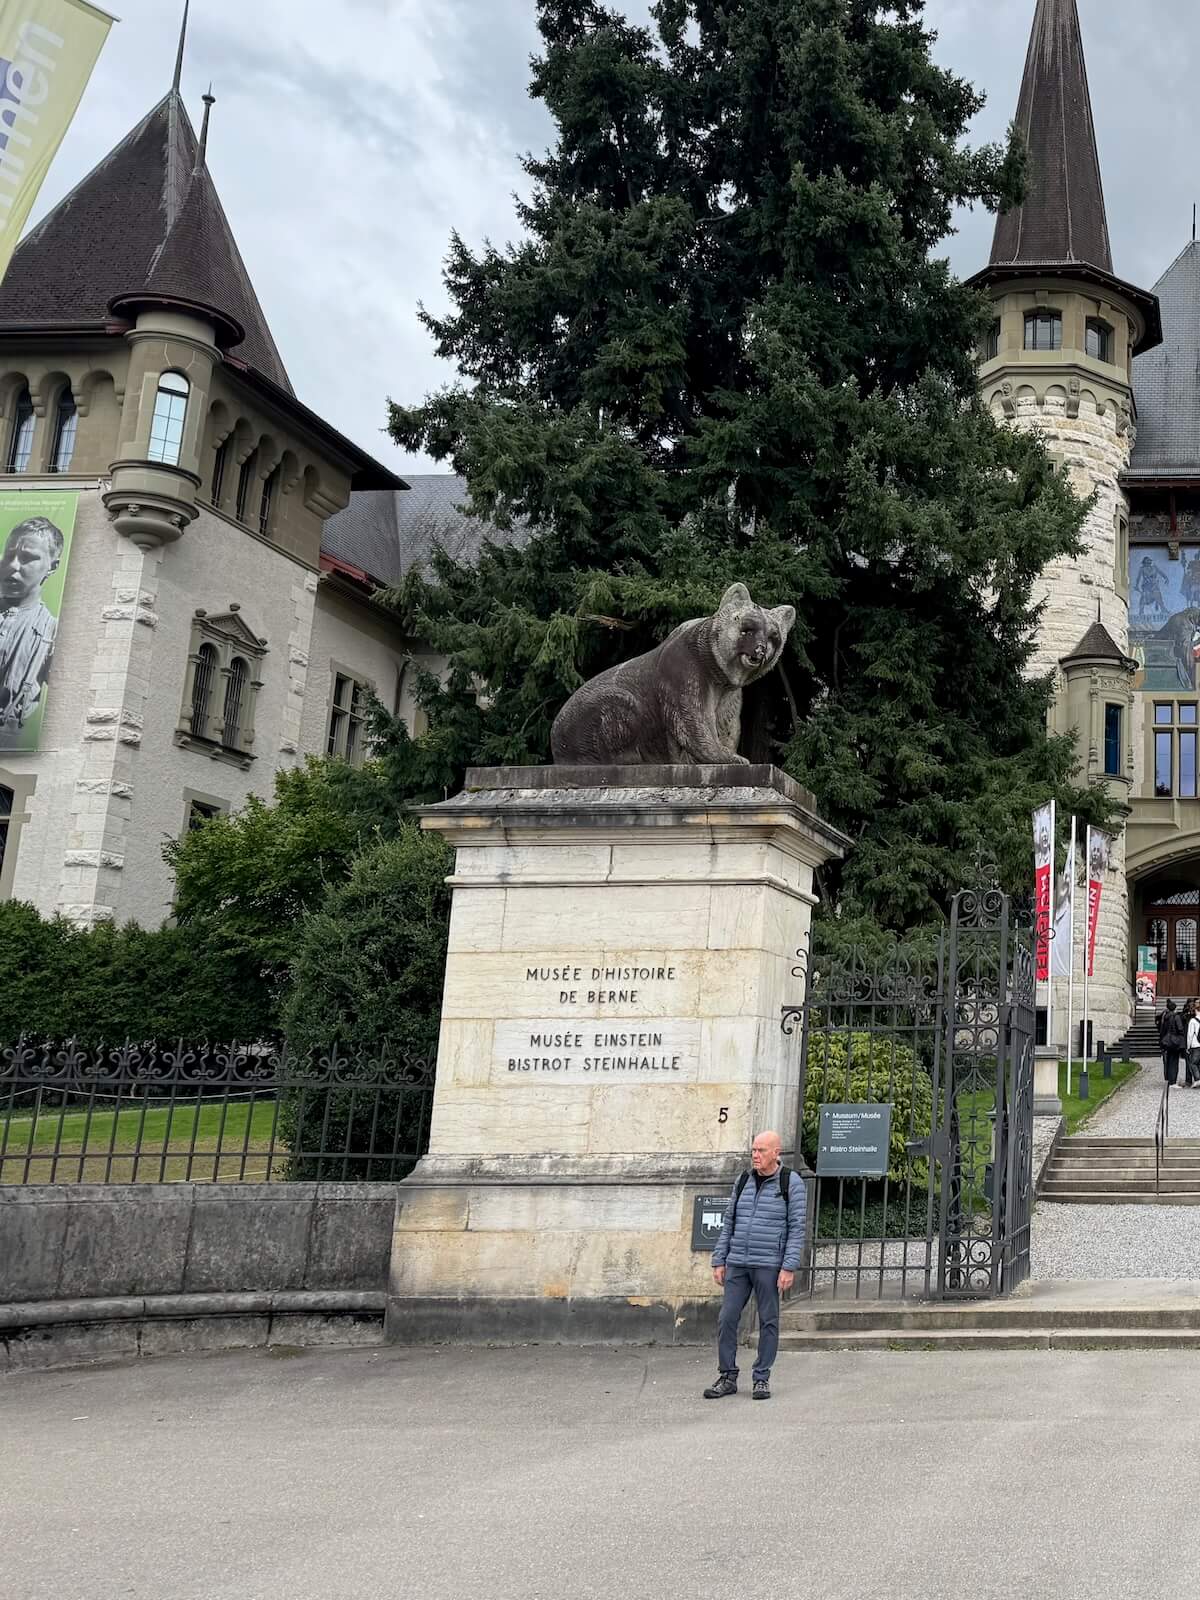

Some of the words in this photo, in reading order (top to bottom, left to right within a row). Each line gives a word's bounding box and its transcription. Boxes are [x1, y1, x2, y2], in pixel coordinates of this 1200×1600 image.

[526, 964, 582, 981] MUSÉE
[591, 966, 676, 981] D'HISTOIRE
[559, 990, 577, 1004] DE
[587, 990, 638, 1004] BERNE
[529, 1030, 584, 1048] MUSÉE
[594, 1032, 662, 1048] EINSTEIN
[507, 1056, 572, 1072] BISTROT
[583, 1055, 681, 1072] STEINHALLE
[717, 1107, 729, 1124] 5
